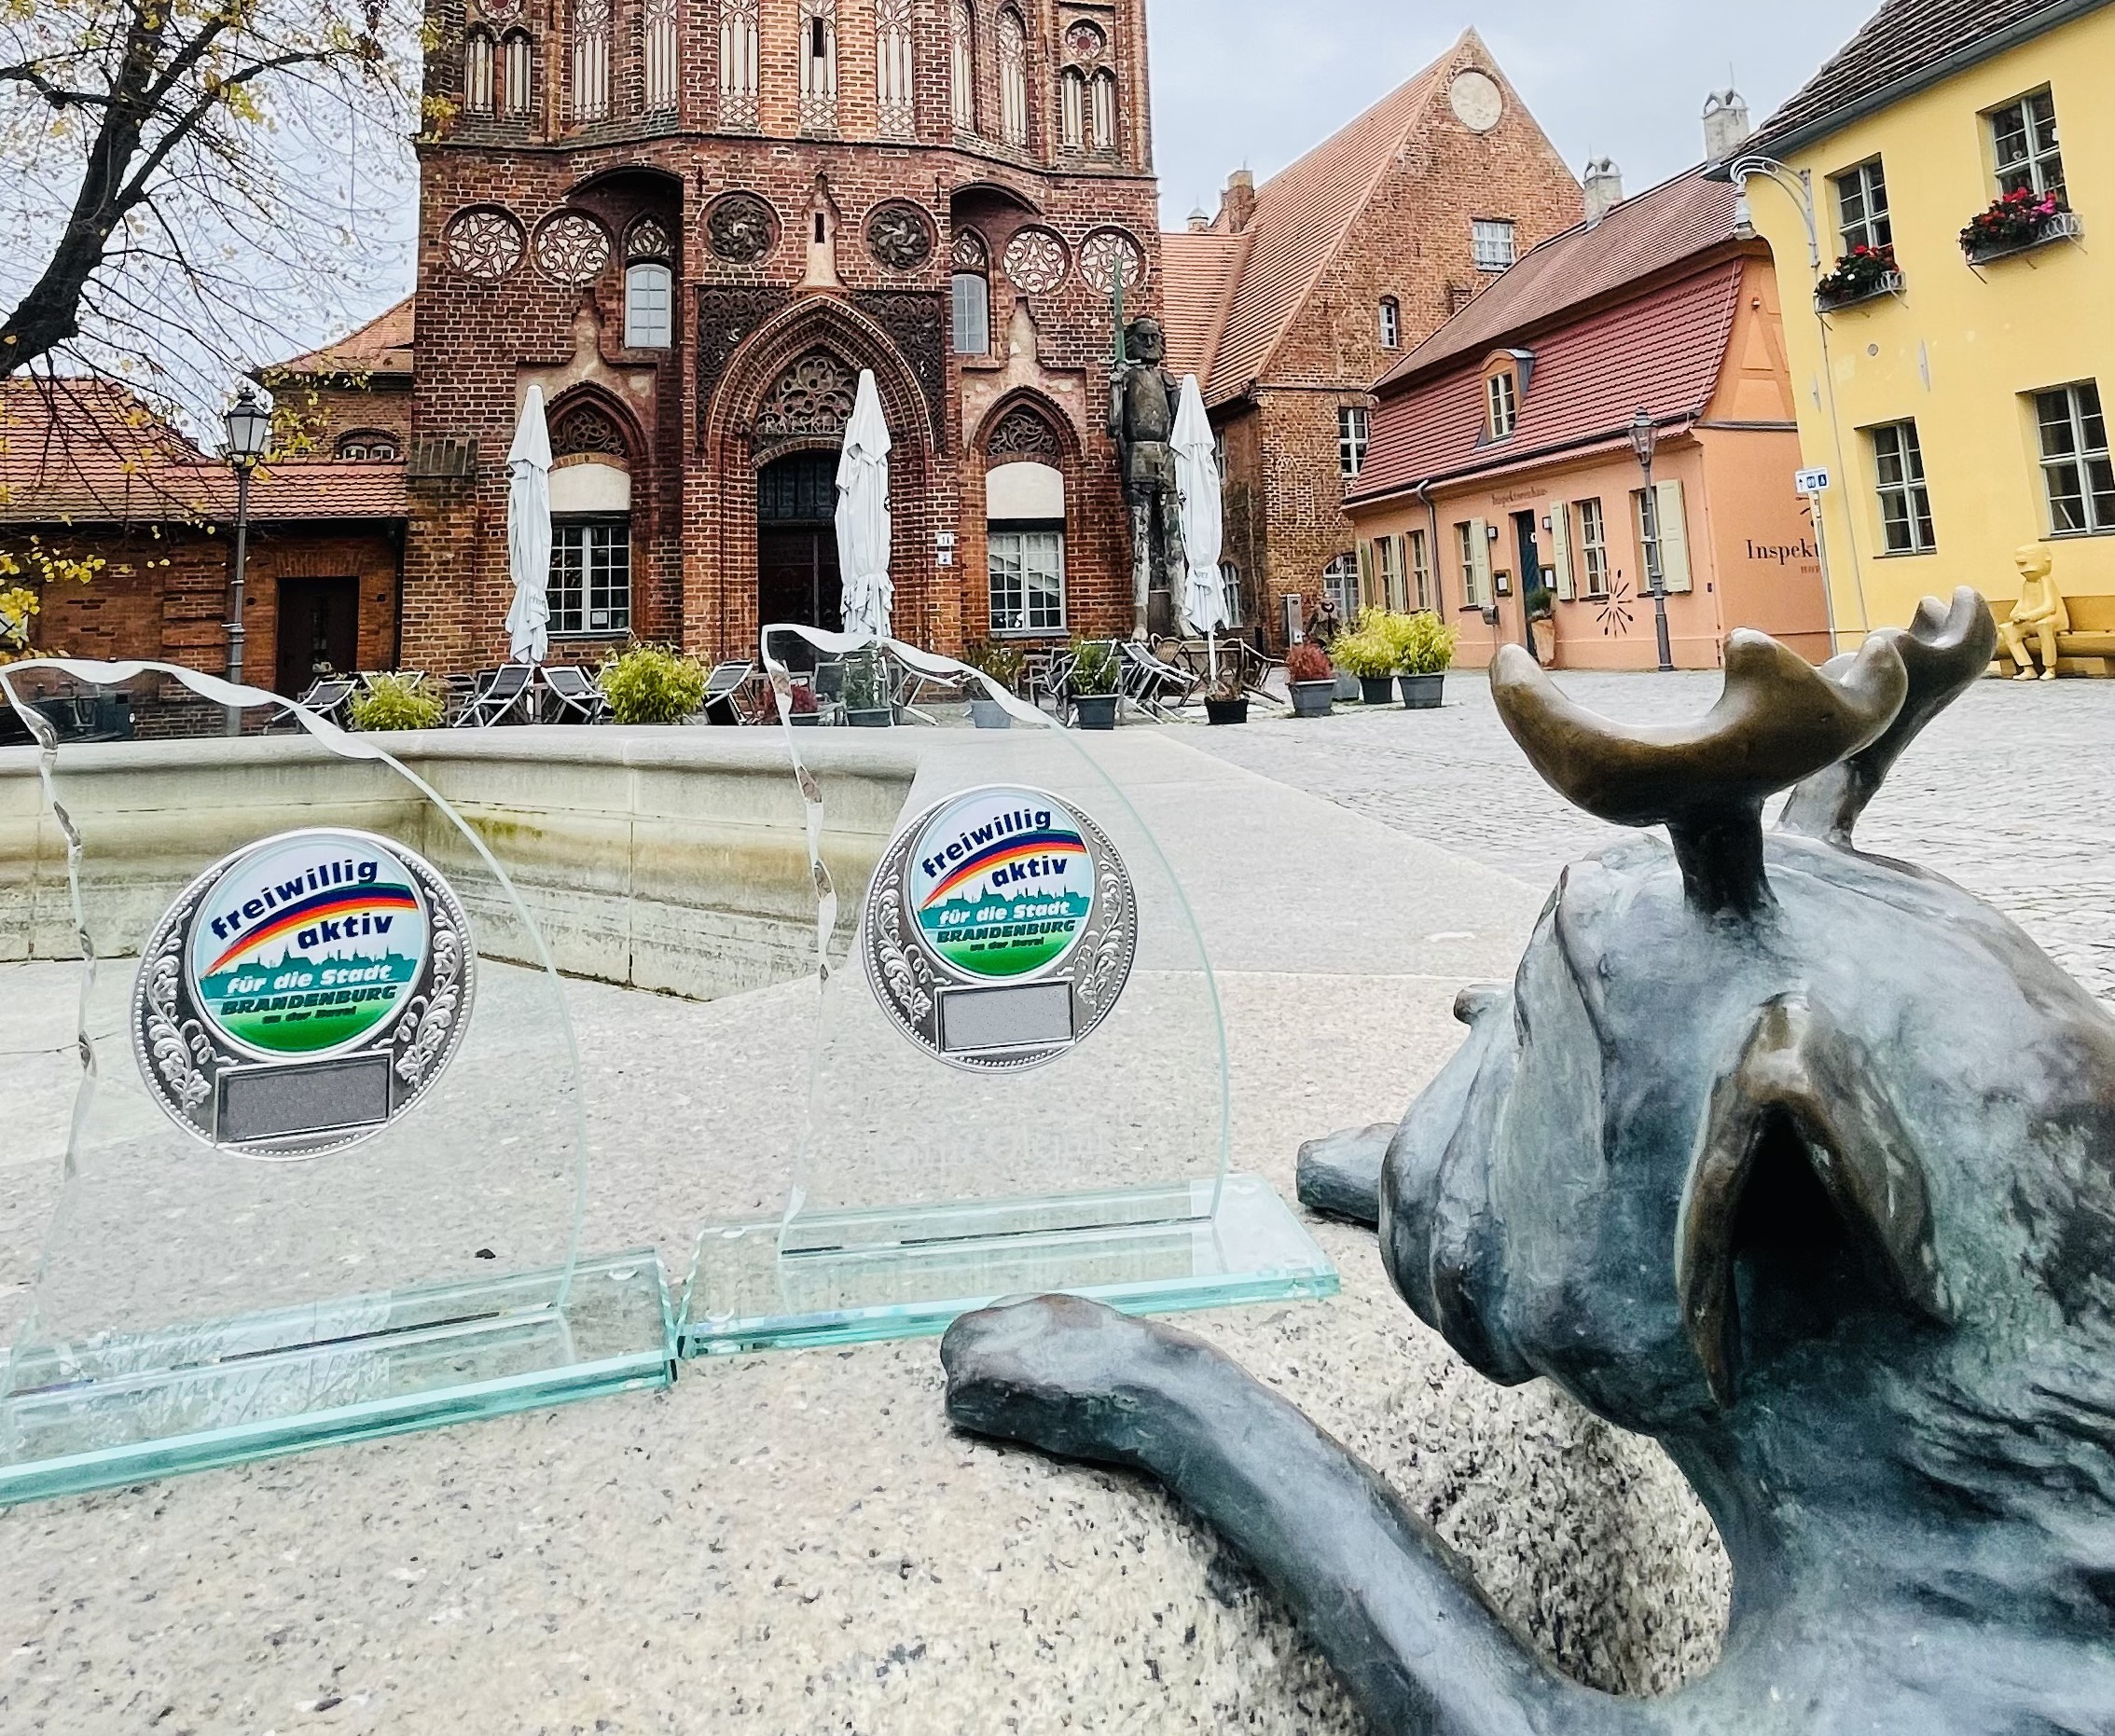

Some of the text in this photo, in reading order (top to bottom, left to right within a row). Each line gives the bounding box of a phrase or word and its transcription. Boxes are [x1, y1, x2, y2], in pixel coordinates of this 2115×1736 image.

[921, 808, 1051, 878] freiwillig
[991, 855, 1068, 888] aktiv
[211, 859, 378, 941] freiwillig
[939, 900, 1071, 926] für die Stadt
[297, 912, 394, 950] aktiv
[936, 919, 1076, 944] BRANDENBURG
[227, 964, 393, 994] für die Stadt
[220, 985, 398, 1015] BRANDENBURG
